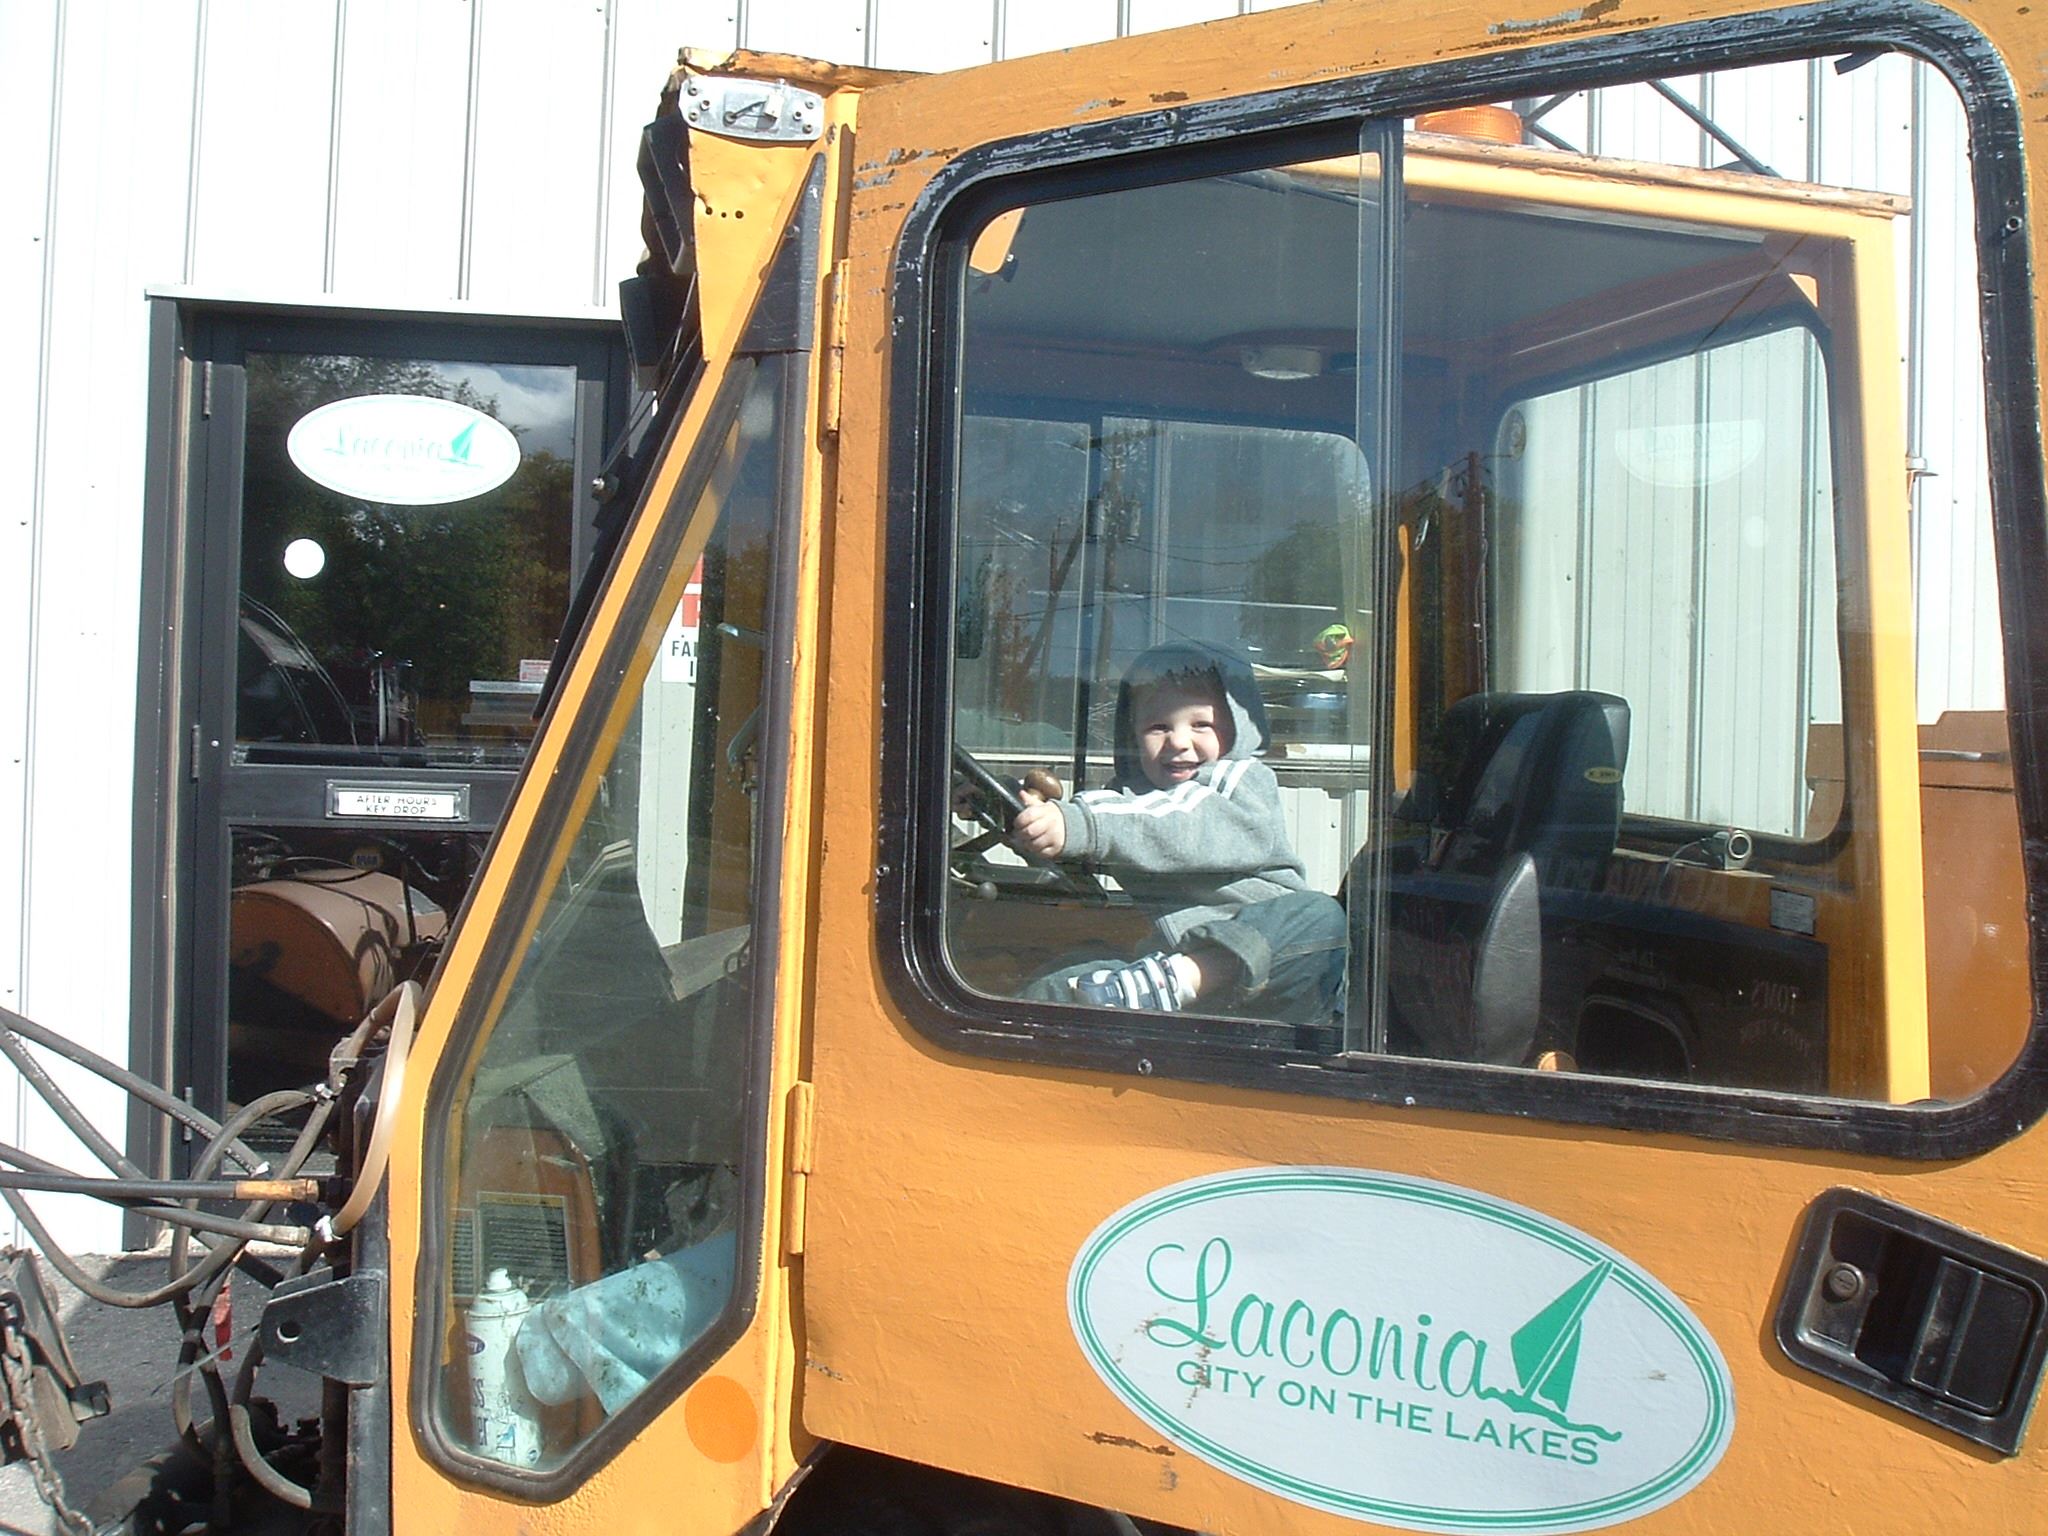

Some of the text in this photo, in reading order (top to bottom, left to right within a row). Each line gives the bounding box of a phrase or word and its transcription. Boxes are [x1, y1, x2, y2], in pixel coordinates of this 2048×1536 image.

[357, 795, 437, 806] AFTER HOURS
[366, 805, 427, 815] KEY DROP
[1146, 1236, 1495, 1399] Laconia
[1175, 1359, 1600, 1466] CITY ON THE LAKES
